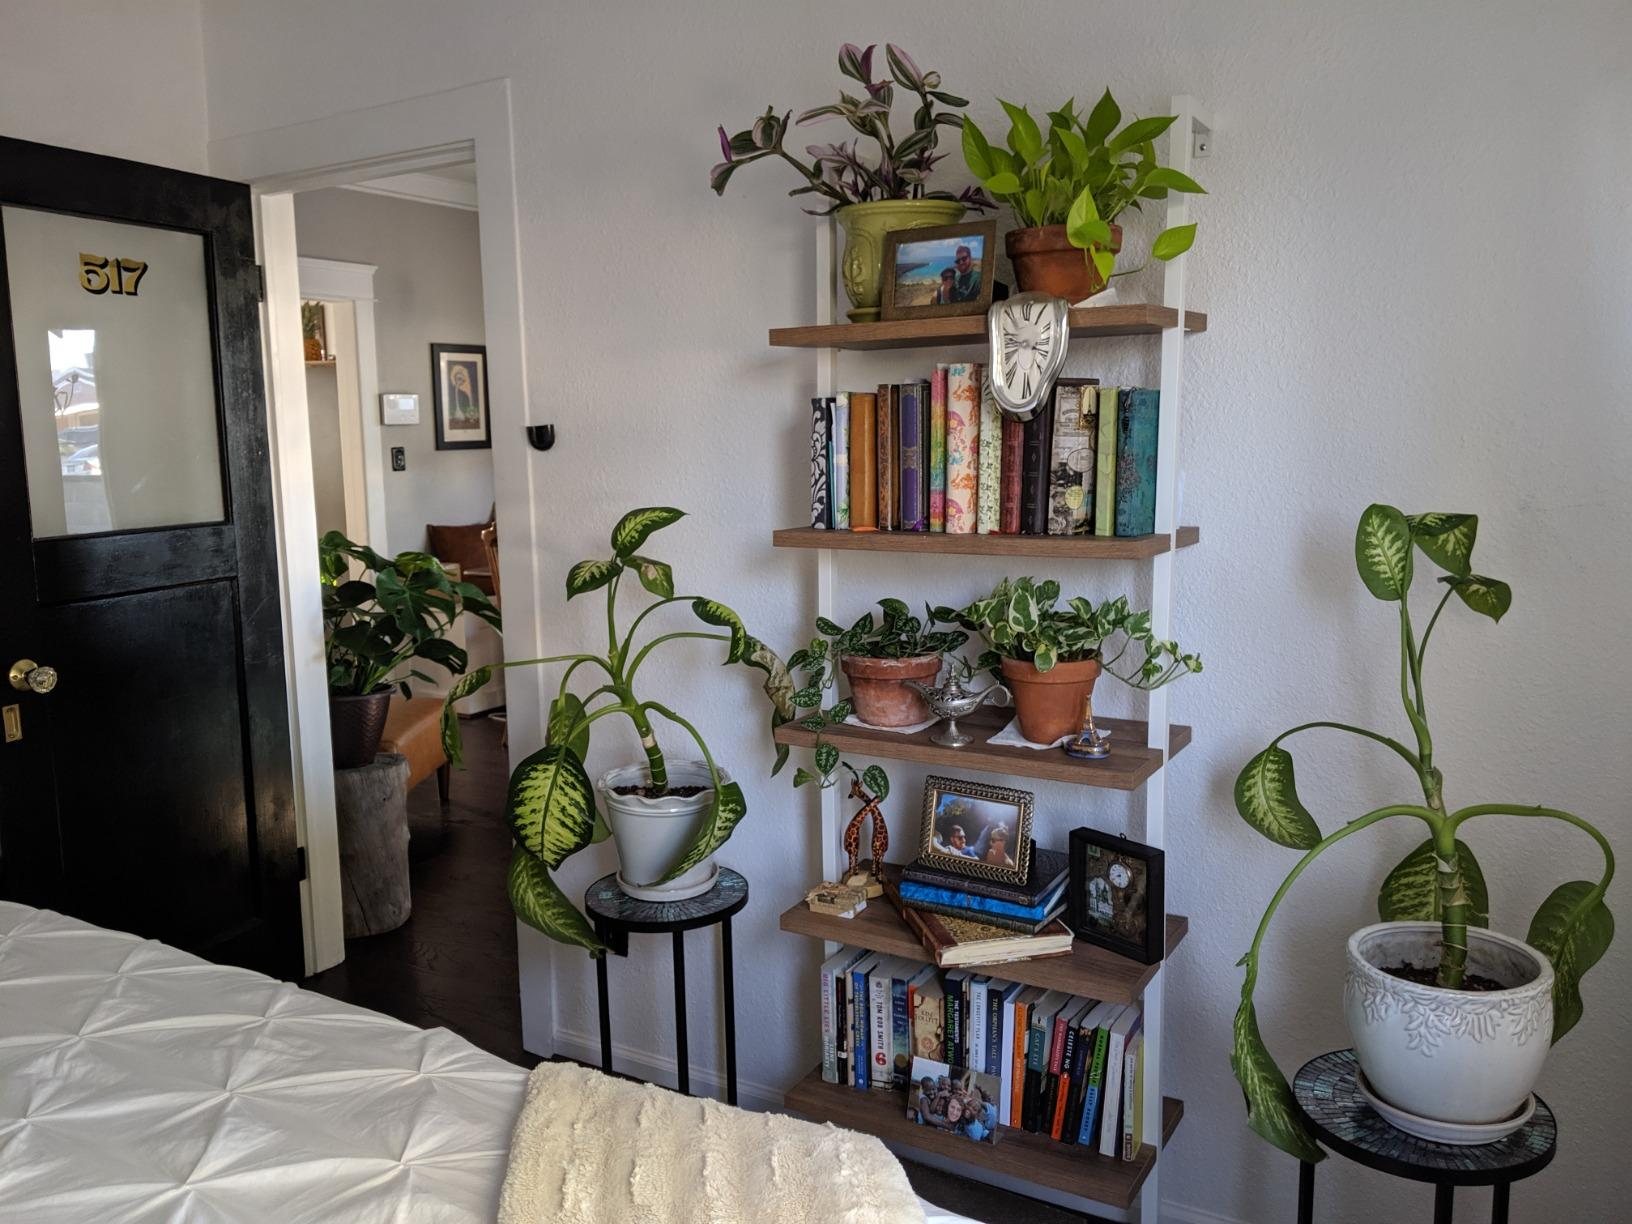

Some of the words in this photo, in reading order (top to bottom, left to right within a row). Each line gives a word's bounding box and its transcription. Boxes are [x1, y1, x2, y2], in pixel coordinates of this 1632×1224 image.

[79, 252, 148, 296] 517
[1067, 1030, 1075, 1058] CELESTE
[1064, 1058, 1071, 1069] NG
